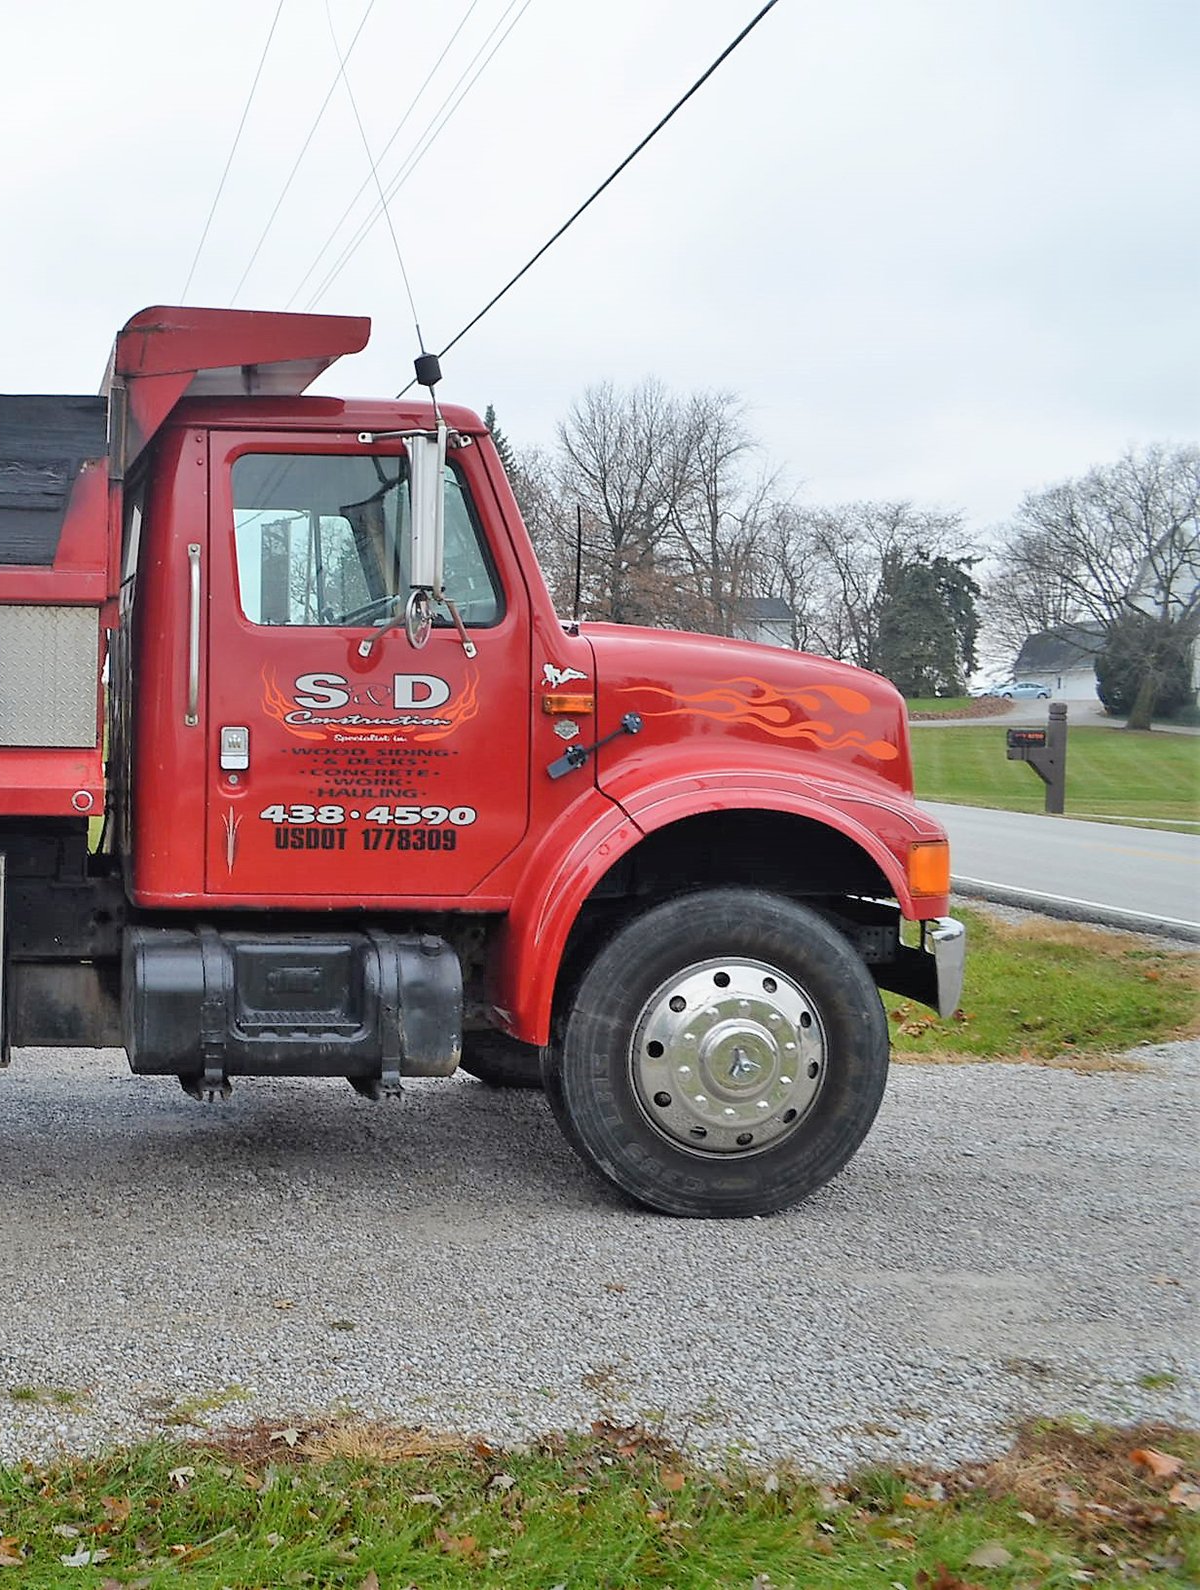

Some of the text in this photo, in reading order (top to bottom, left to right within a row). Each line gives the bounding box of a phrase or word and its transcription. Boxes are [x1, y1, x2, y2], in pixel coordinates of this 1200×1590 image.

[294, 672, 351, 710] S
[393, 673, 452, 710] D
[284, 710, 452, 727] Construction
[333, 733, 390, 743] Specialist
[291, 747, 450, 757] WOOD SIDING
[323, 757, 418, 766] & DECKS
[310, 768, 430, 777] CONCRETE
[333, 778, 404, 786] WORK
[316, 787, 418, 798] HAULING
[275, 827, 457, 851] USDOT 1778309
